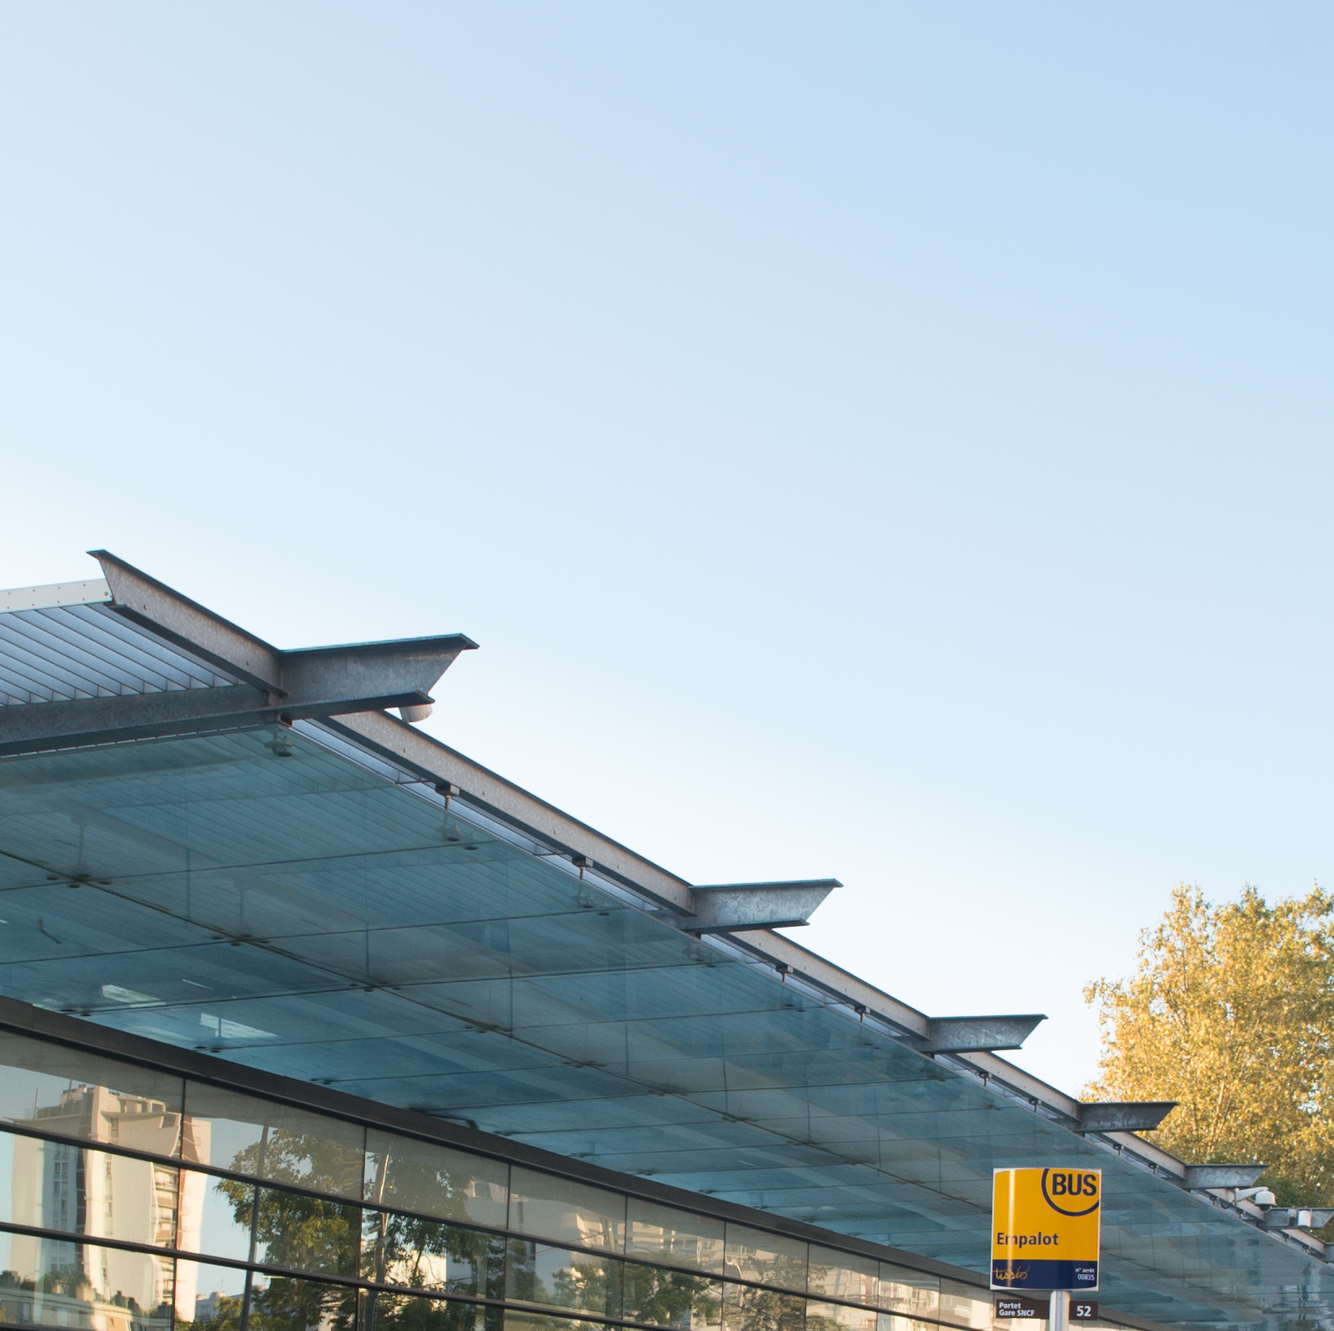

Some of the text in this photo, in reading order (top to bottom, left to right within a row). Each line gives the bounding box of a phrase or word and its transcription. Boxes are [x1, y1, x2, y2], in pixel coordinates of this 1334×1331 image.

[1052, 1173, 1097, 1196] BUS
[996, 1231, 1059, 1248] Empalot
[998, 1301, 1021, 1309] Portet
[1076, 1305, 1092, 1317] 52
[1017, 1309, 1035, 1317] SNCF
